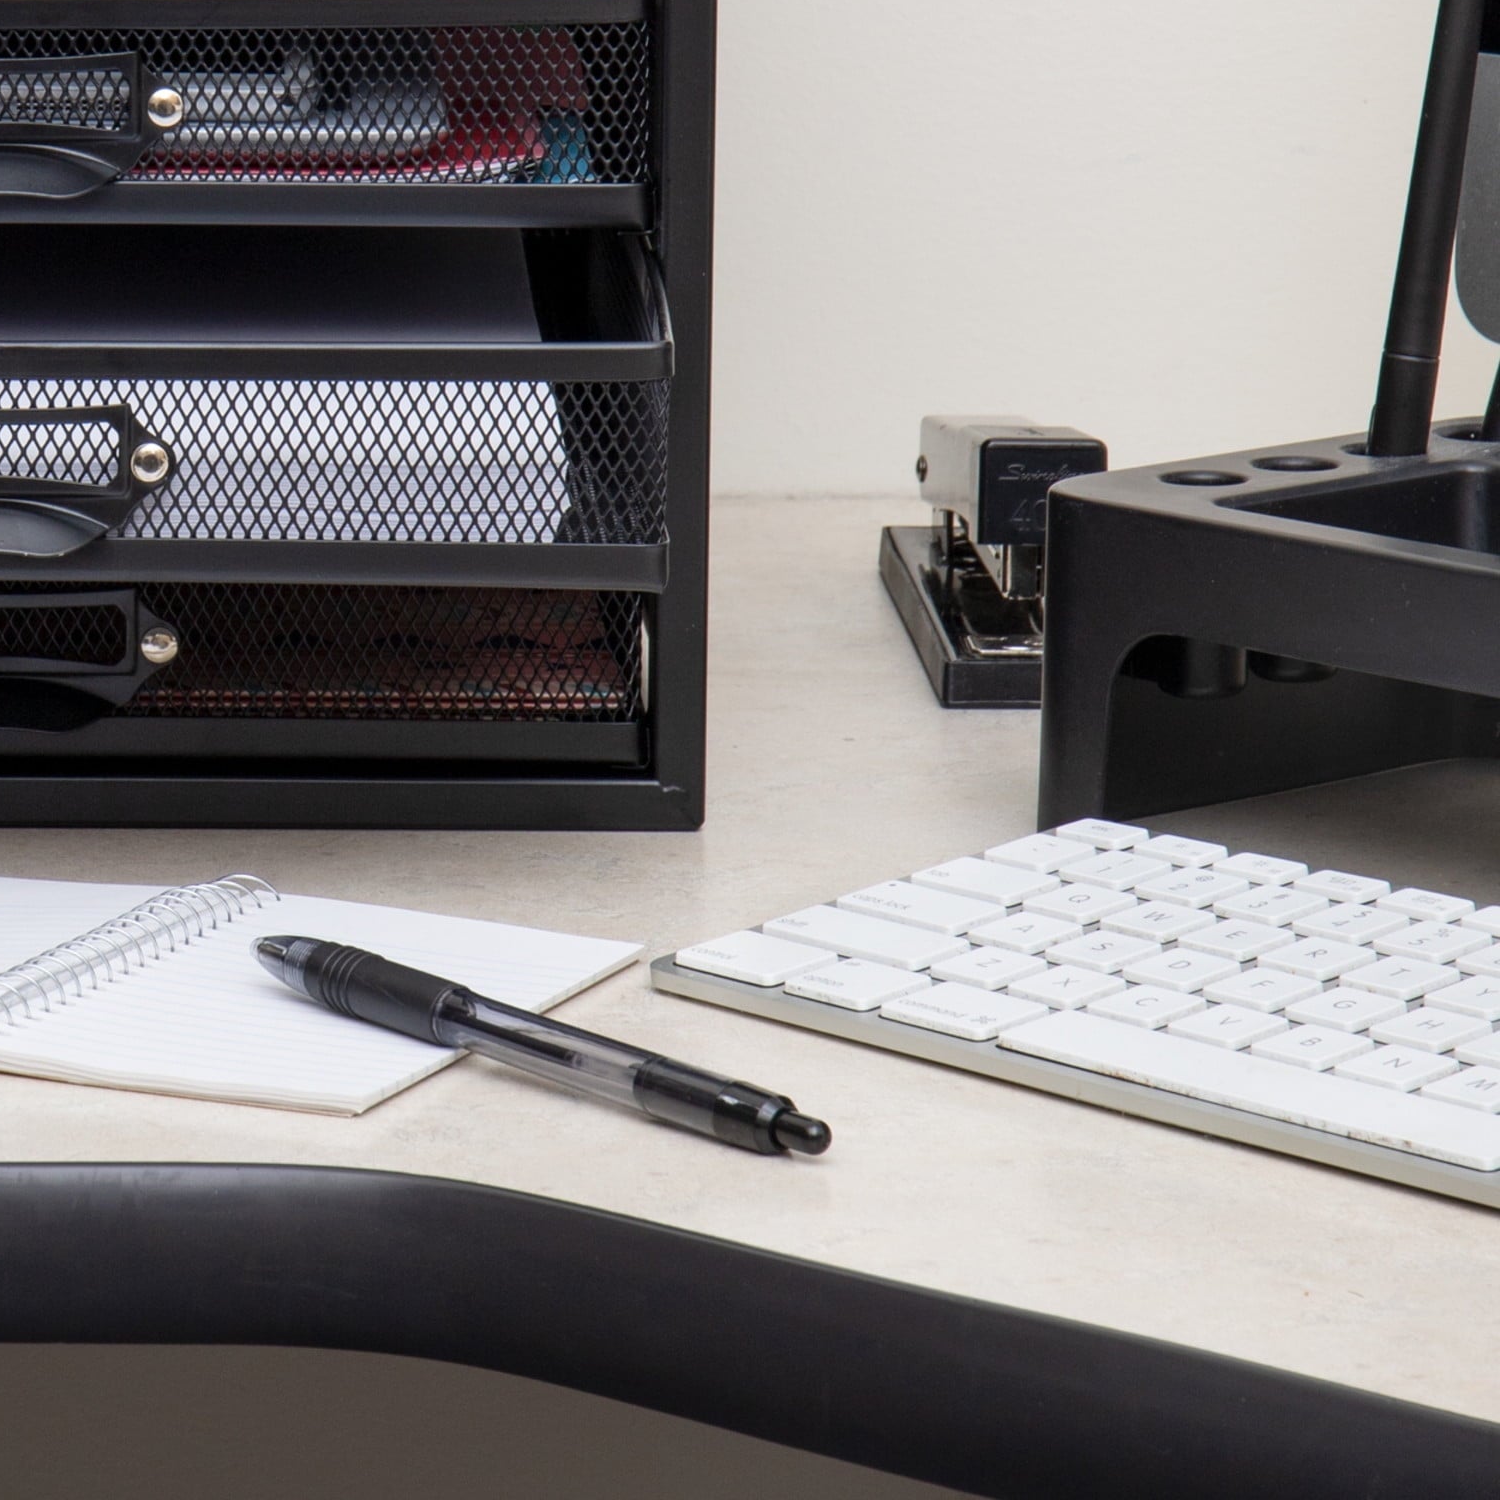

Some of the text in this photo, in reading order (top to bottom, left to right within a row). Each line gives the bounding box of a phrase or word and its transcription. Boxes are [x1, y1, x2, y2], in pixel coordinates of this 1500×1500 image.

[1068, 894, 1091, 904] Q
[1143, 911, 1173, 922] W
[1011, 924, 1035, 933] A
[1225, 930, 1248, 940] E
[1092, 942, 1114, 951] S
[1305, 948, 1328, 959] R
[1168, 959, 1192, 970] D
[1389, 968, 1412, 977] T
[1052, 977, 1081, 988] X
[1250, 979, 1276, 989] F
[1136, 996, 1160, 1007] C
[1333, 999, 1358, 1010] G
[1220, 1016, 1243, 1026] V
[1416, 1019, 1445, 1031] H
[1299, 1036, 1323, 1047] B
[1382, 1057, 1413, 1069] N
[1465, 1078, 1499, 1091] M
